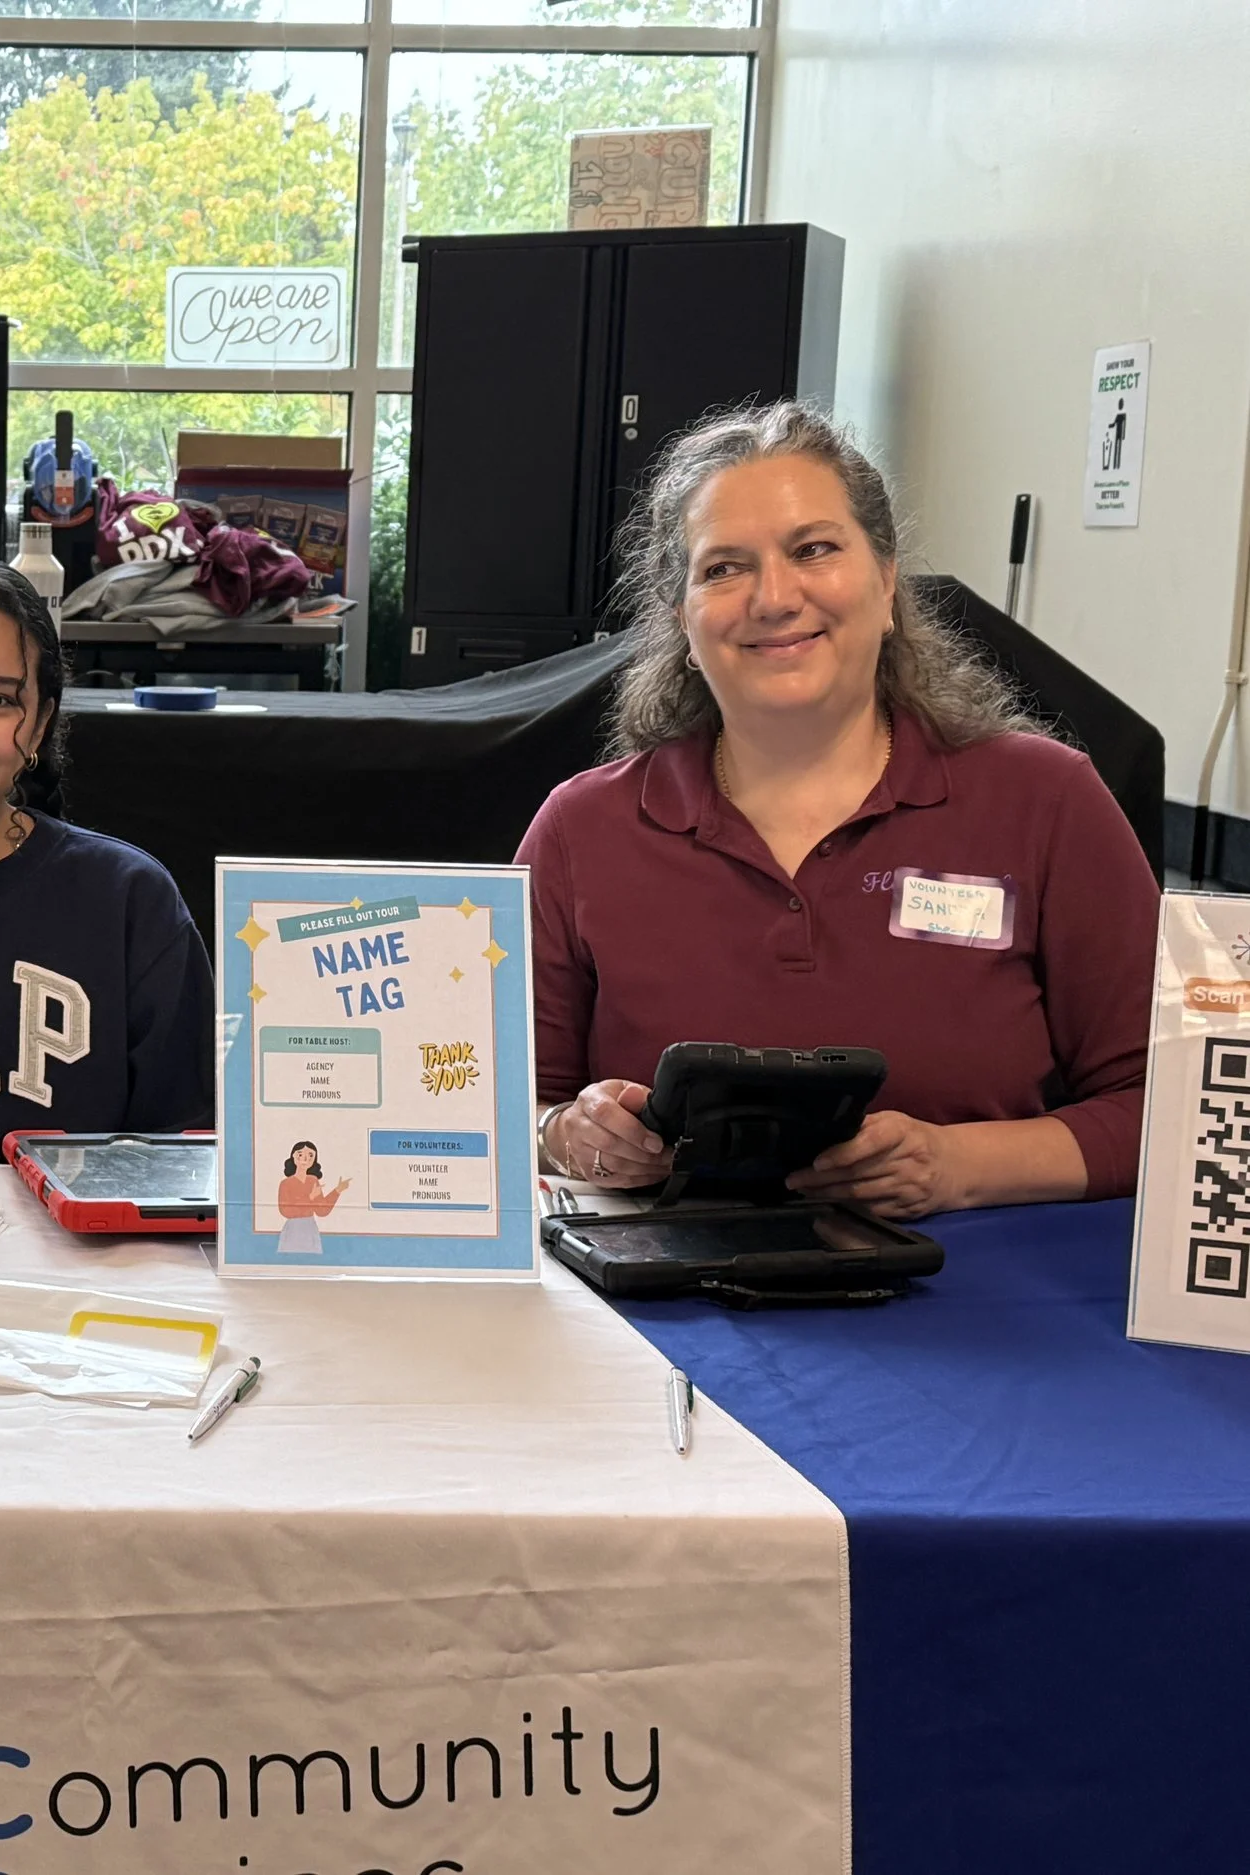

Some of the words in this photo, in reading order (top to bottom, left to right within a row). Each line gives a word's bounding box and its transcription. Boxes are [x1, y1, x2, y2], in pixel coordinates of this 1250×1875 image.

[180, 287, 333, 363] Open
[1098, 372, 1141, 392] RESPECT
[300, 917, 335, 931] PLEASE
[336, 914, 354, 925] FILL
[356, 911, 372, 921] OUT
[375, 906, 400, 918] YOUR
[312, 931, 410, 978] NAME
[336, 977, 404, 1018] TAG
[1193, 982, 1245, 1005] Scan
[288, 1037, 303, 1045] FOR
[305, 1037, 327, 1045] TABLE
[330, 1038, 351, 1046] HOST:
[418, 1041, 478, 1069] THANK
[306, 1062, 334, 1071] AGENCY
[310, 1076, 330, 1085] NAME
[428, 1066, 466, 1096] YOU
[302, 1090, 341, 1099] PRONOUNS
[397, 1141, 411, 1149] FOR
[408, 1164, 448, 1173] VOLUNTEER
[418, 1178, 438, 1187] NAME
[412, 1190, 451, 1200] PRONOUNS
